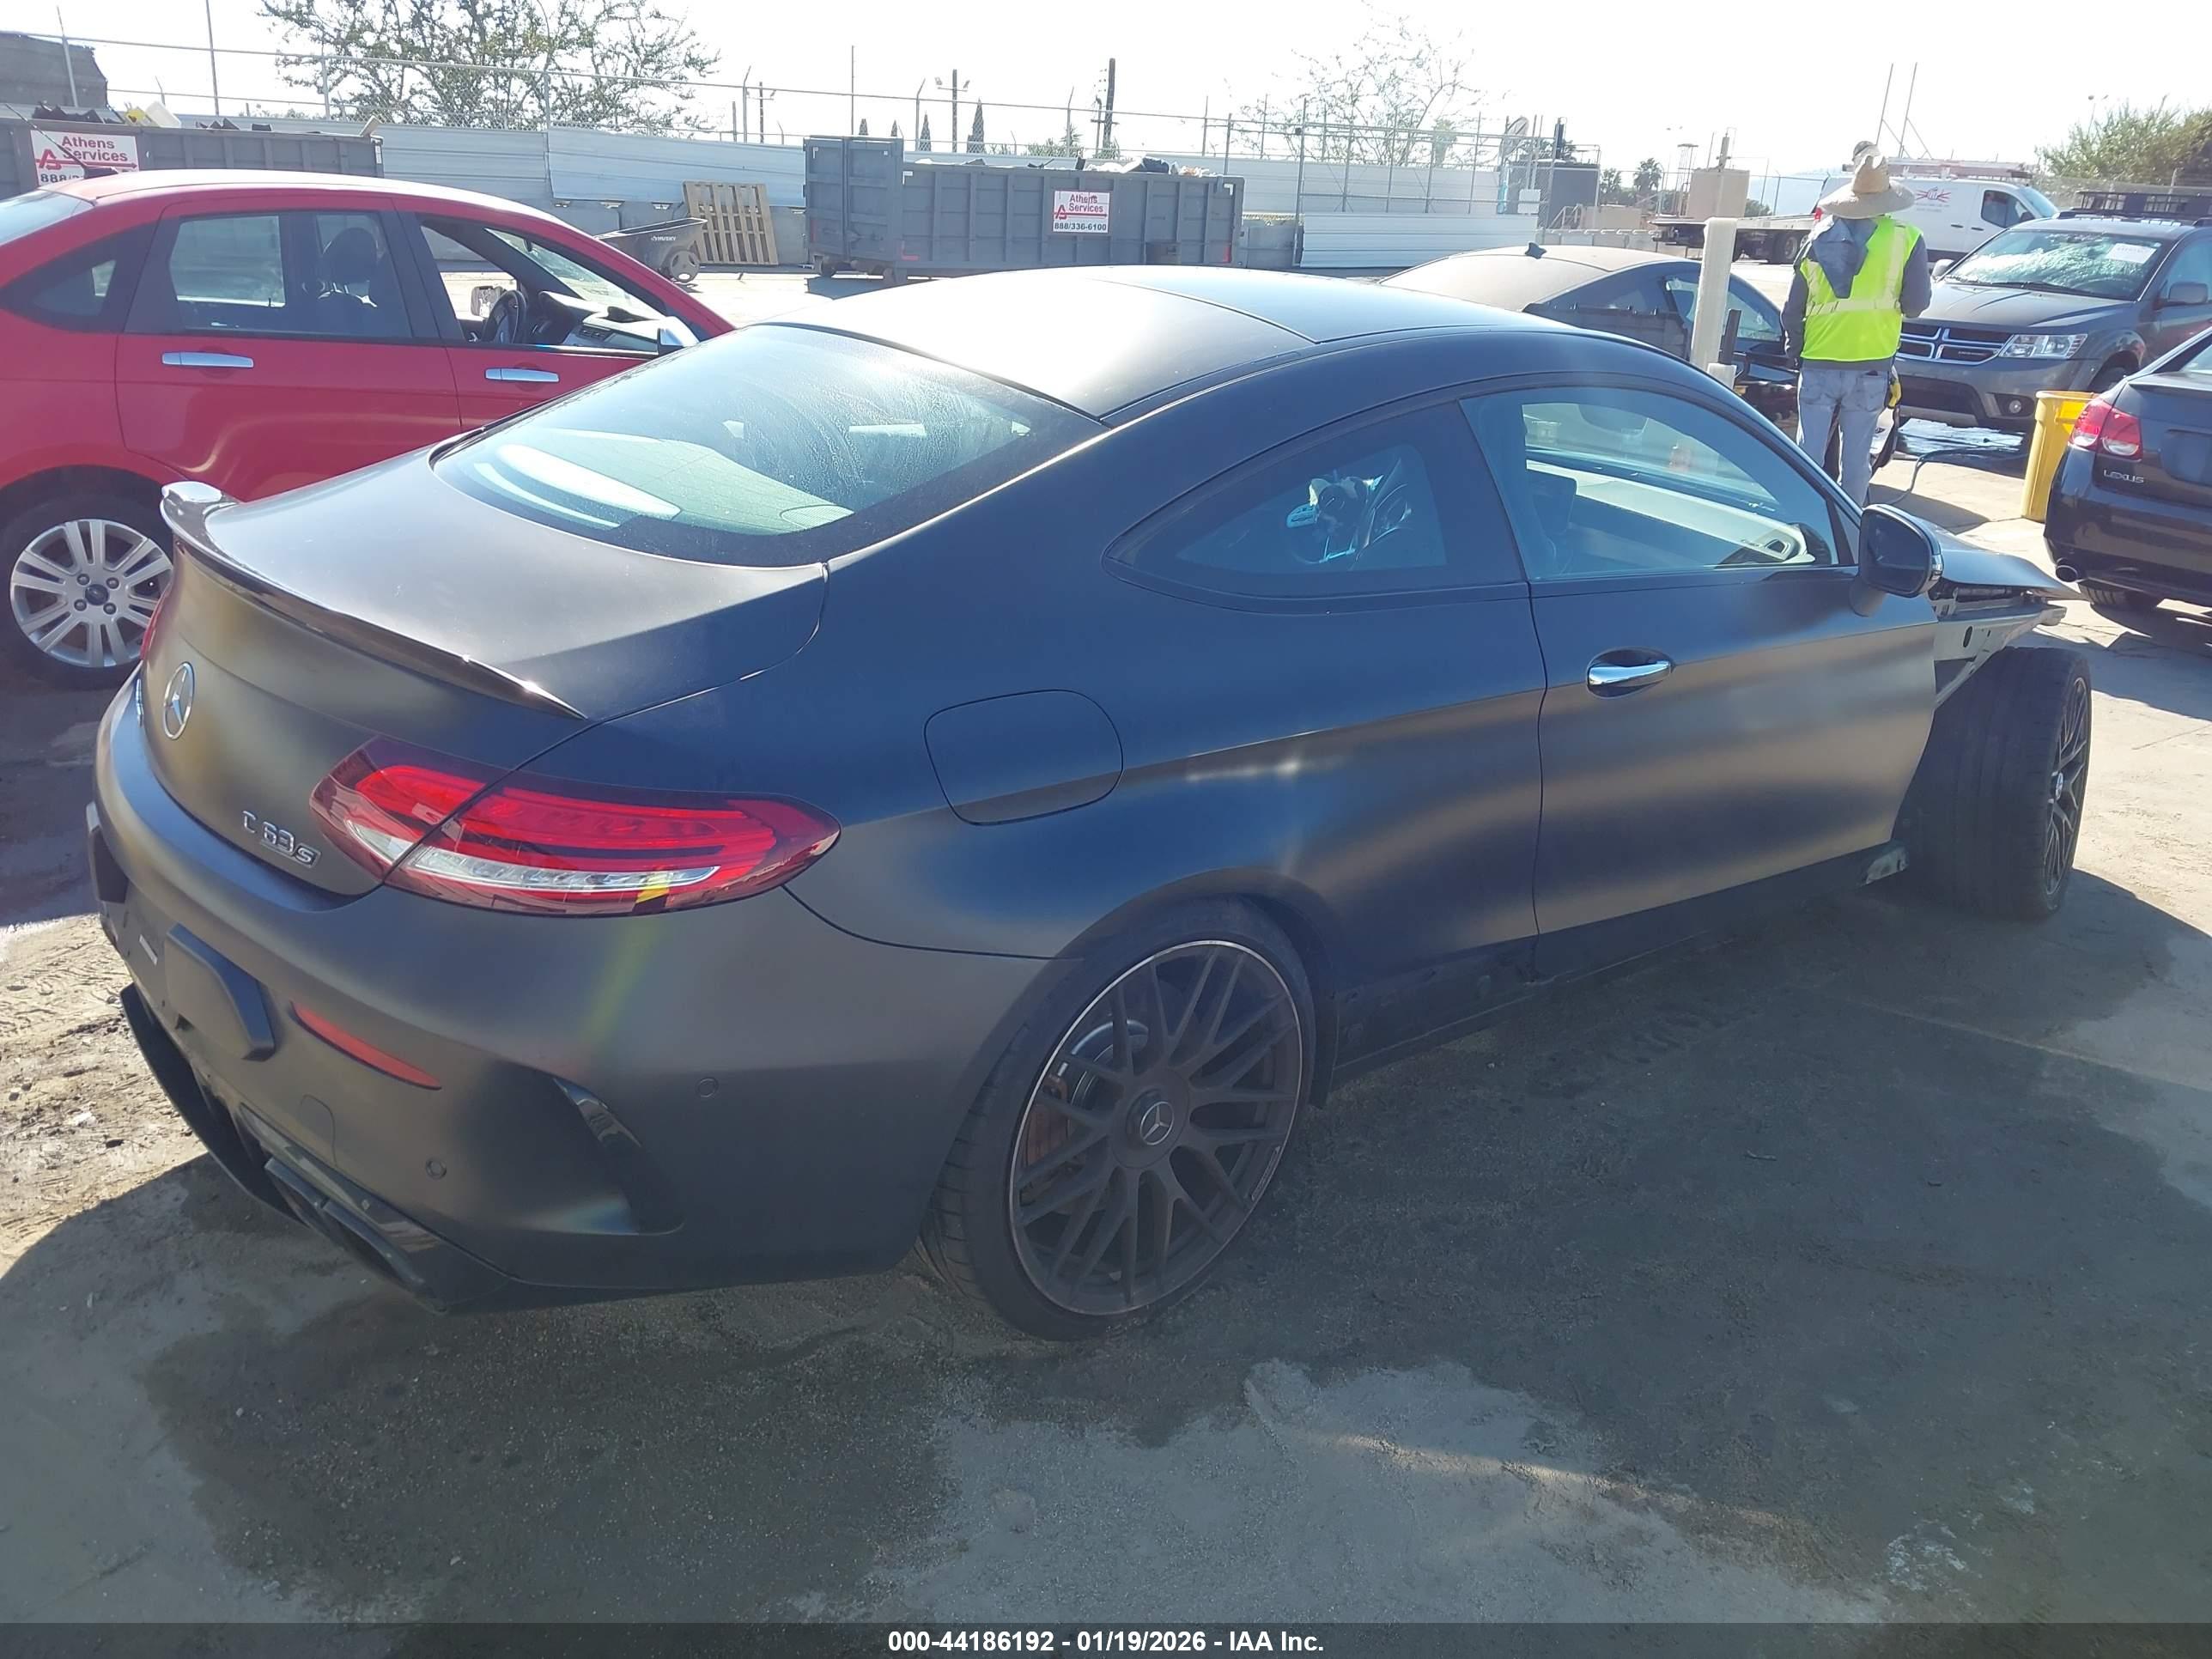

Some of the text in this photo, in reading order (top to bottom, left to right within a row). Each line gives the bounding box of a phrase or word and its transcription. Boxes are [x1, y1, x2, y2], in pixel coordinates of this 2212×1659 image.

[62, 136, 115, 149] Athens
[1070, 194, 1097, 204] Athens
[1069, 203, 1103, 212] Services
[1054, 222, 1107, 231] 888/336-6100
[2103, 469, 2144, 483] LEXUS
[242, 810, 257, 834] C
